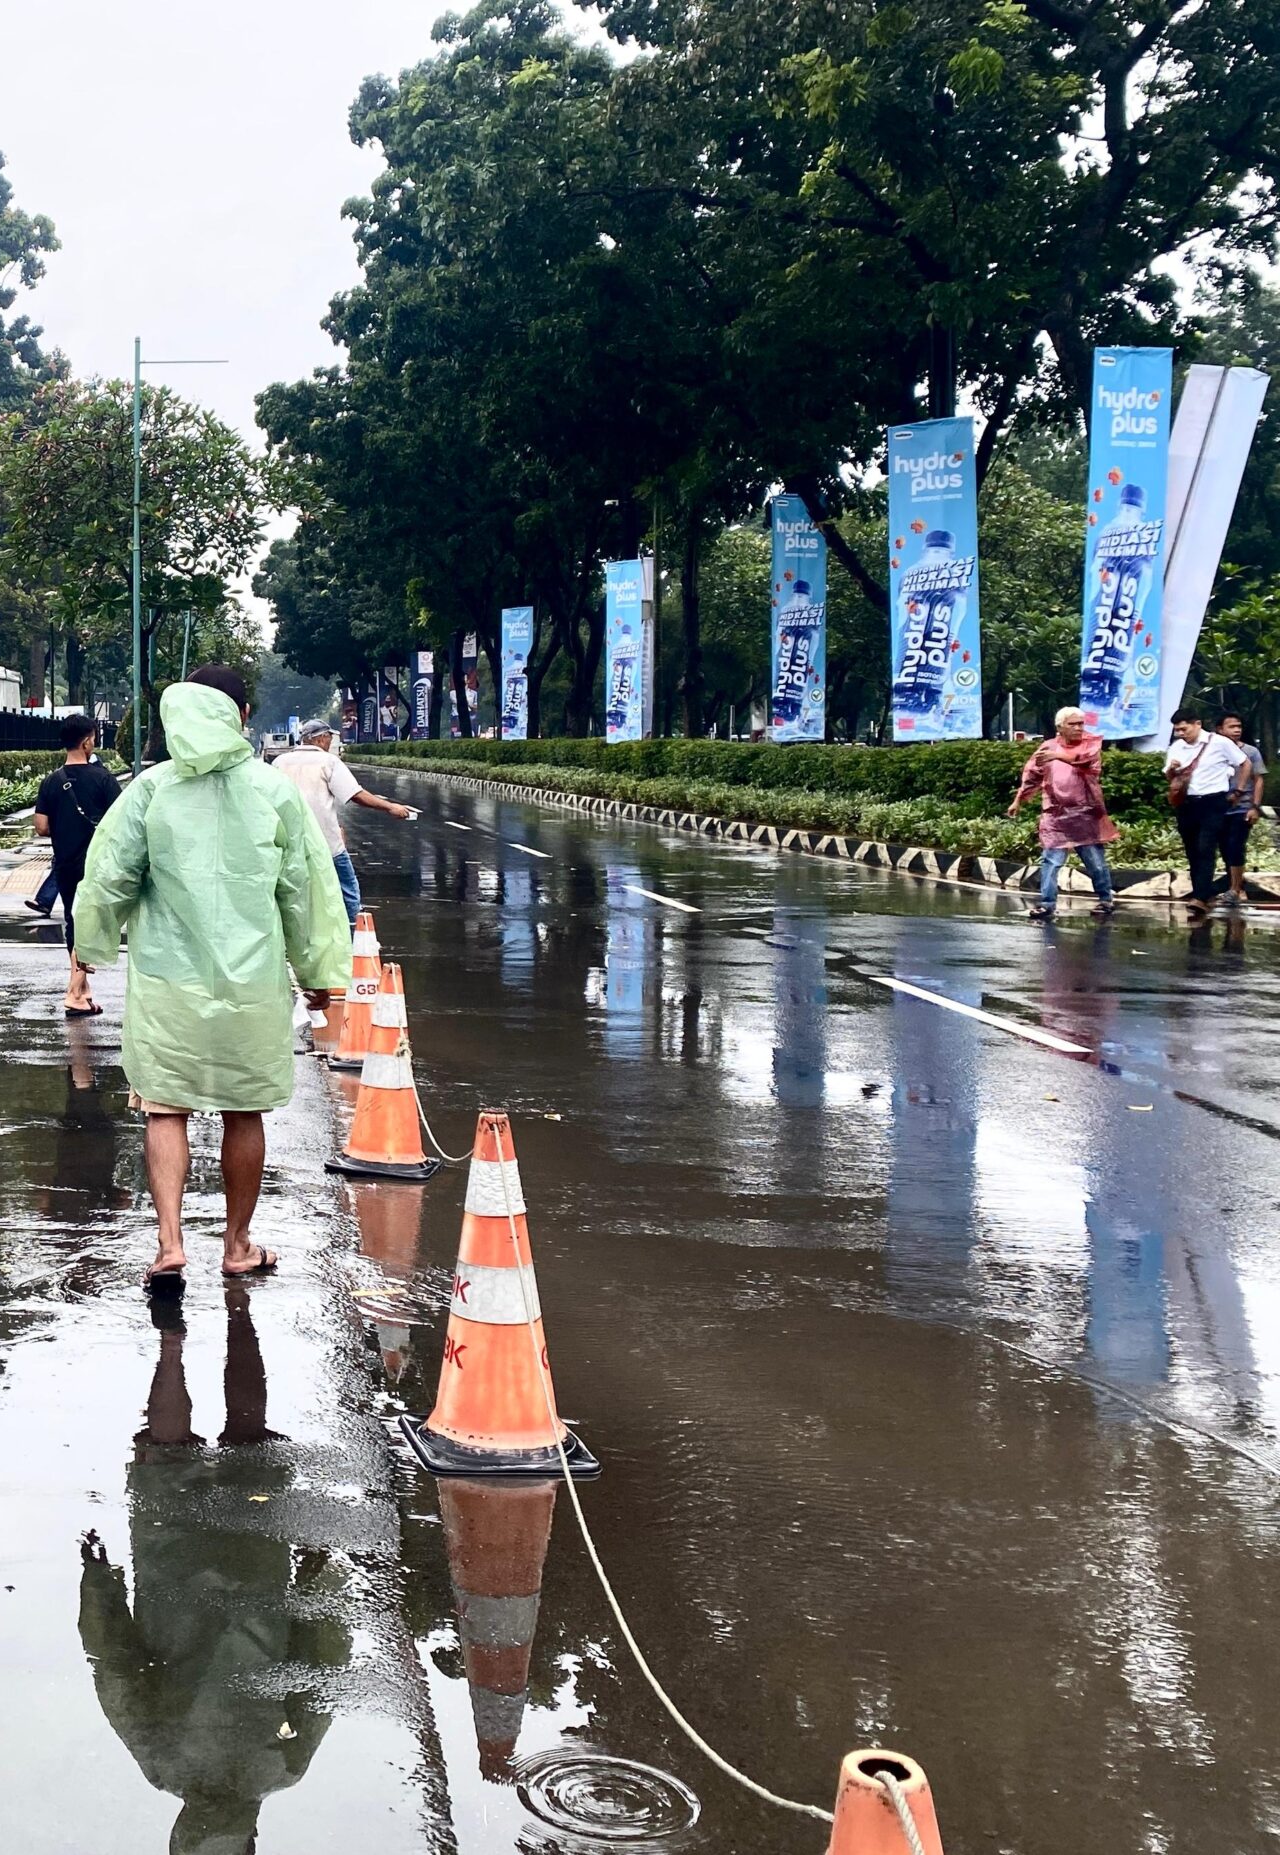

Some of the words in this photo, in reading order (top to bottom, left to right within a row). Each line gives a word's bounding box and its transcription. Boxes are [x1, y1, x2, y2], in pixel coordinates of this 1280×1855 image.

[1098, 385, 1160, 415] hydro
[1111, 411, 1158, 437] plus
[894, 451, 963, 478] hydro
[911, 472, 963, 496] plus
[776, 518, 819, 537] hydro
[785, 534, 819, 551] plus
[902, 576, 972, 594] MAKSIMAL
[903, 564, 974, 587] HIDRASI
[779, 609, 824, 621] HIDRASI
[1082, 570, 1117, 674] hydro
[1111, 576, 1137, 652] plus
[896, 601, 930, 688] hydro
[925, 605, 951, 669] plus
[773, 635, 795, 700] hydro
[791, 638, 809, 687] plus
[608, 665, 622, 713] hydro
[620, 665, 631, 702] plus
[416, 685, 425, 727] DAIHATSU
